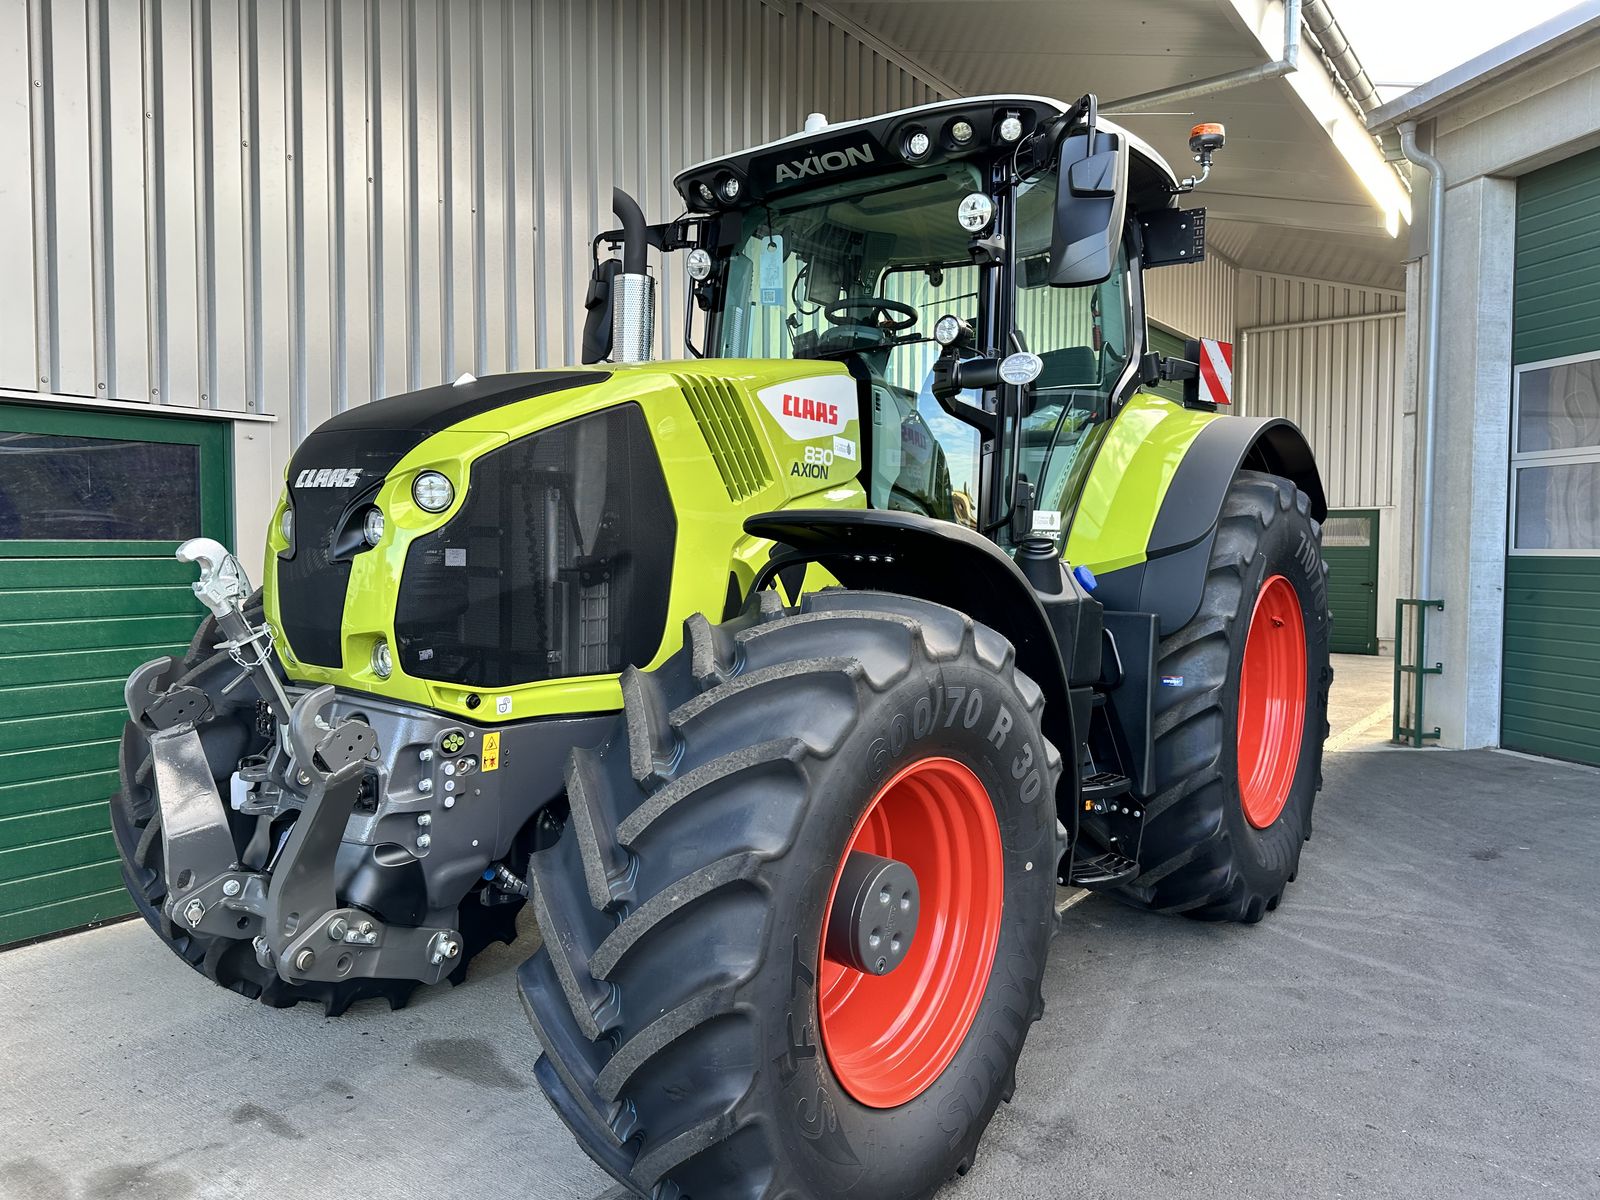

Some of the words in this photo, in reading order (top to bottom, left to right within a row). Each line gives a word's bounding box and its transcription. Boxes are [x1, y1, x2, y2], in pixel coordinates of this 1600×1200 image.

[776, 143, 875, 183] AXION
[782, 394, 838, 426] CLAAS
[804, 446, 834, 466] 830
[294, 468, 364, 489] CLAAS
[790, 462, 829, 480] AXION
[866, 686, 983, 783] 600/70
[986, 703, 1014, 751] R
[1011, 741, 1042, 804] 30
